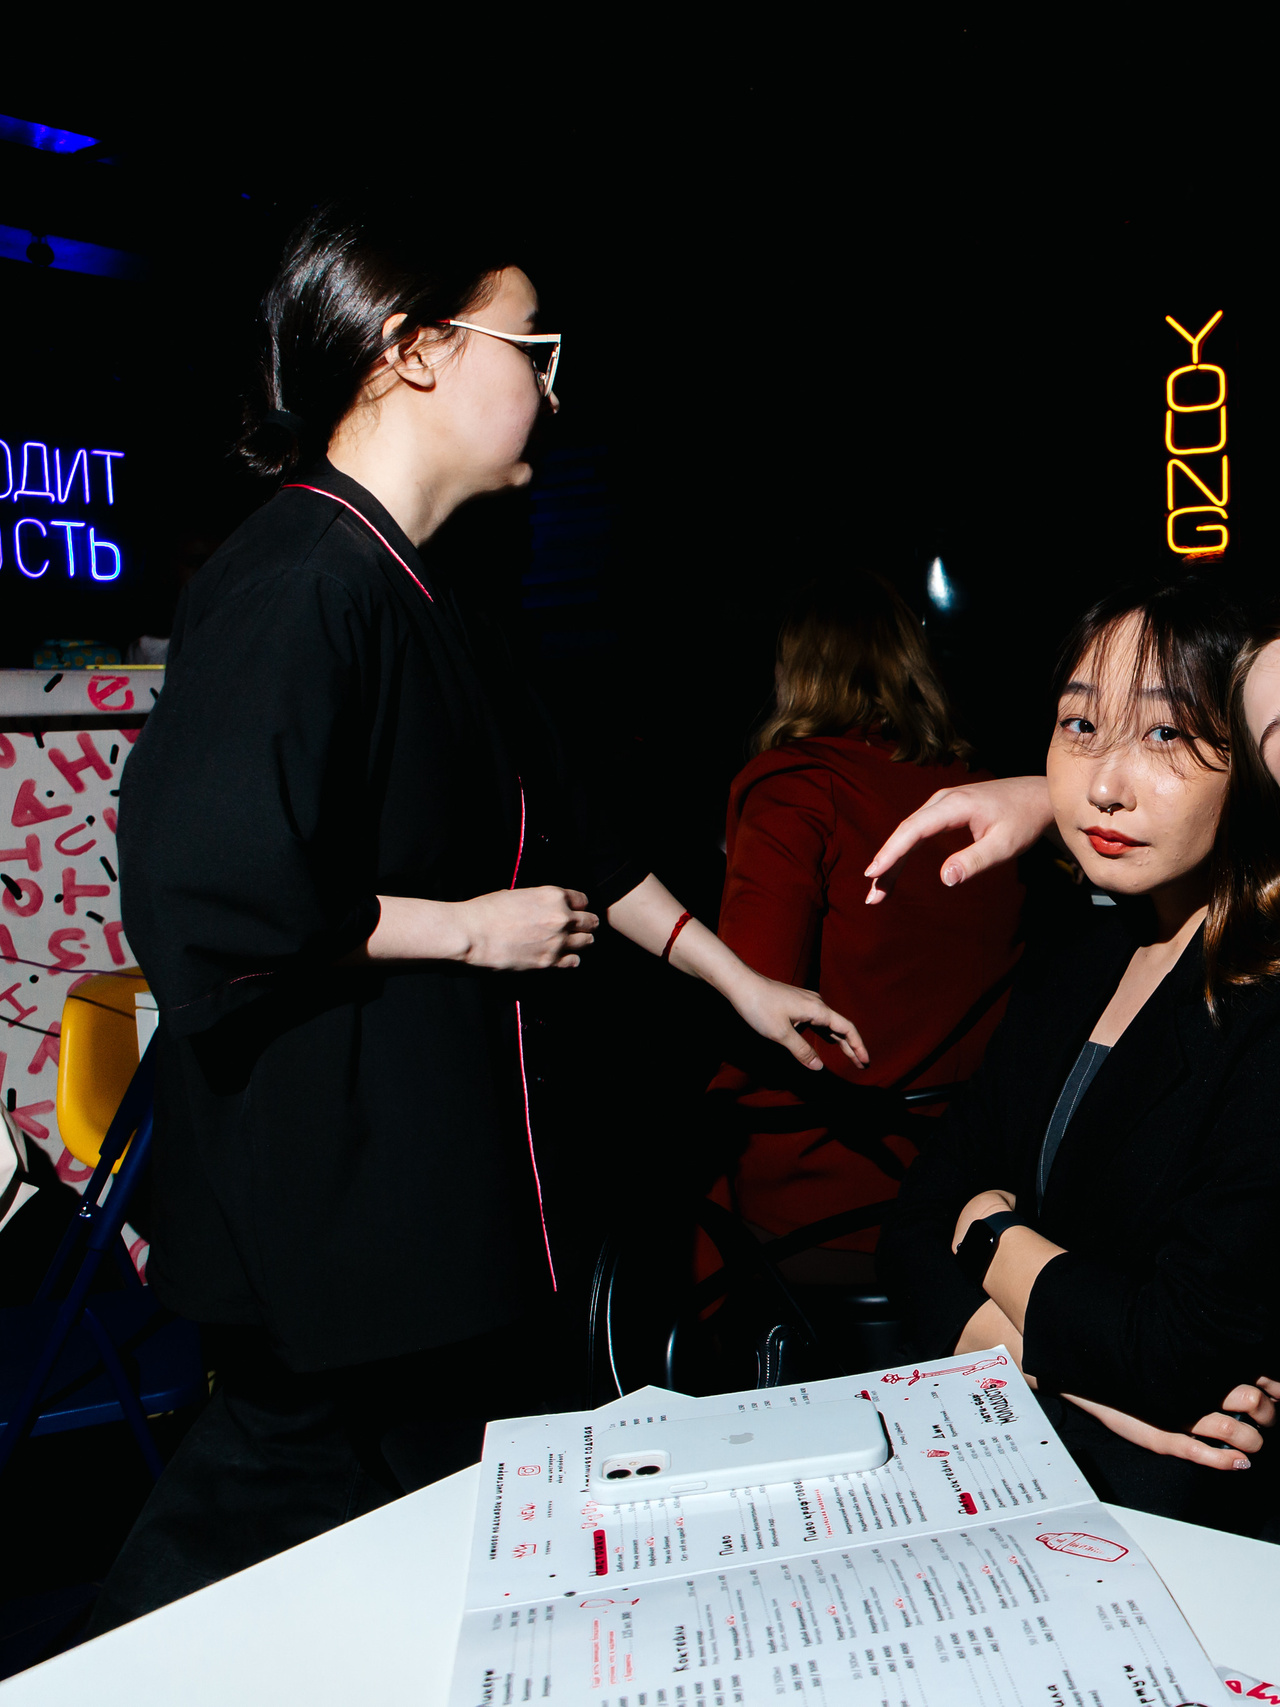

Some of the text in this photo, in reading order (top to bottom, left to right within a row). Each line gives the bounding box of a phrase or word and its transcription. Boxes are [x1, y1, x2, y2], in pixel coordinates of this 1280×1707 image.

[1165, 310, 1229, 554] YOUNG
[0, 518, 121, 581] СТЬ
[973, 1394, 993, 1422] пати-бар
[984, 1384, 1017, 1424] МОЛОДОСТЬ
[932, 1425, 945, 1438] Дым
[940, 1460, 961, 1492] коктейли
[794, 1482, 817, 1541] Пиво крафтовое
[951, 1493, 973, 1514] Пати
[588, 1535, 604, 1577] Настойки
[719, 1536, 733, 1556] Пиво
[673, 1626, 688, 1672] Коктейли
